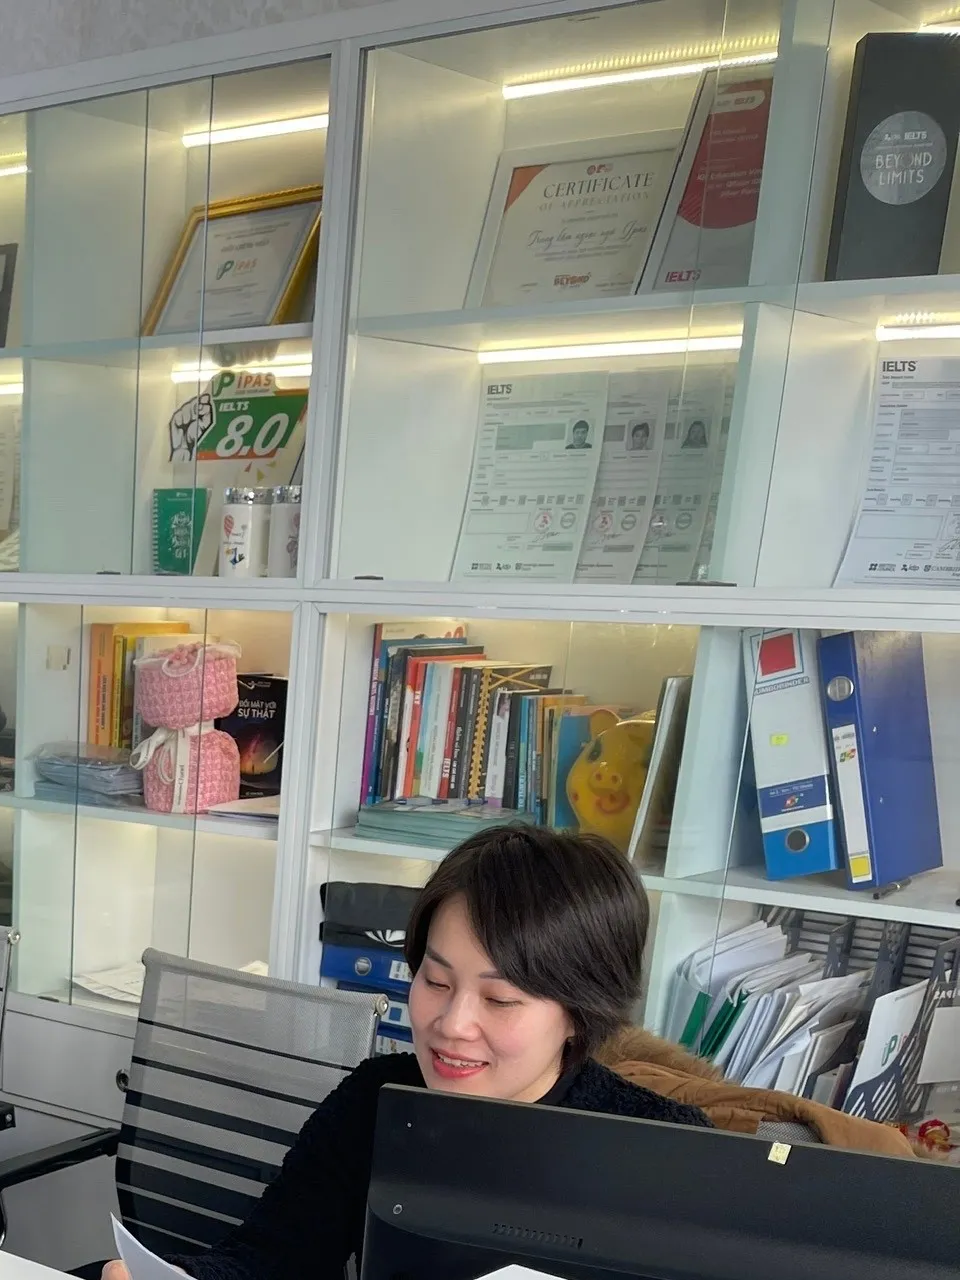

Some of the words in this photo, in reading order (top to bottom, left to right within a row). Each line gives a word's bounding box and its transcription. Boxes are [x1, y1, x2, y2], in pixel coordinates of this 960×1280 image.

[879, 168, 924, 186] LIMITS
[544, 172, 655, 198] CERTIFICATE
[665, 269, 702, 283] IELTS
[882, 360, 916, 372] IELTS
[487, 384, 512, 395] IELTS
[219, 401, 249, 412] IELTS
[216, 413, 289, 458] 8.0
[238, 708, 250, 719] SỰ
[442, 758, 452, 779] IELTS
